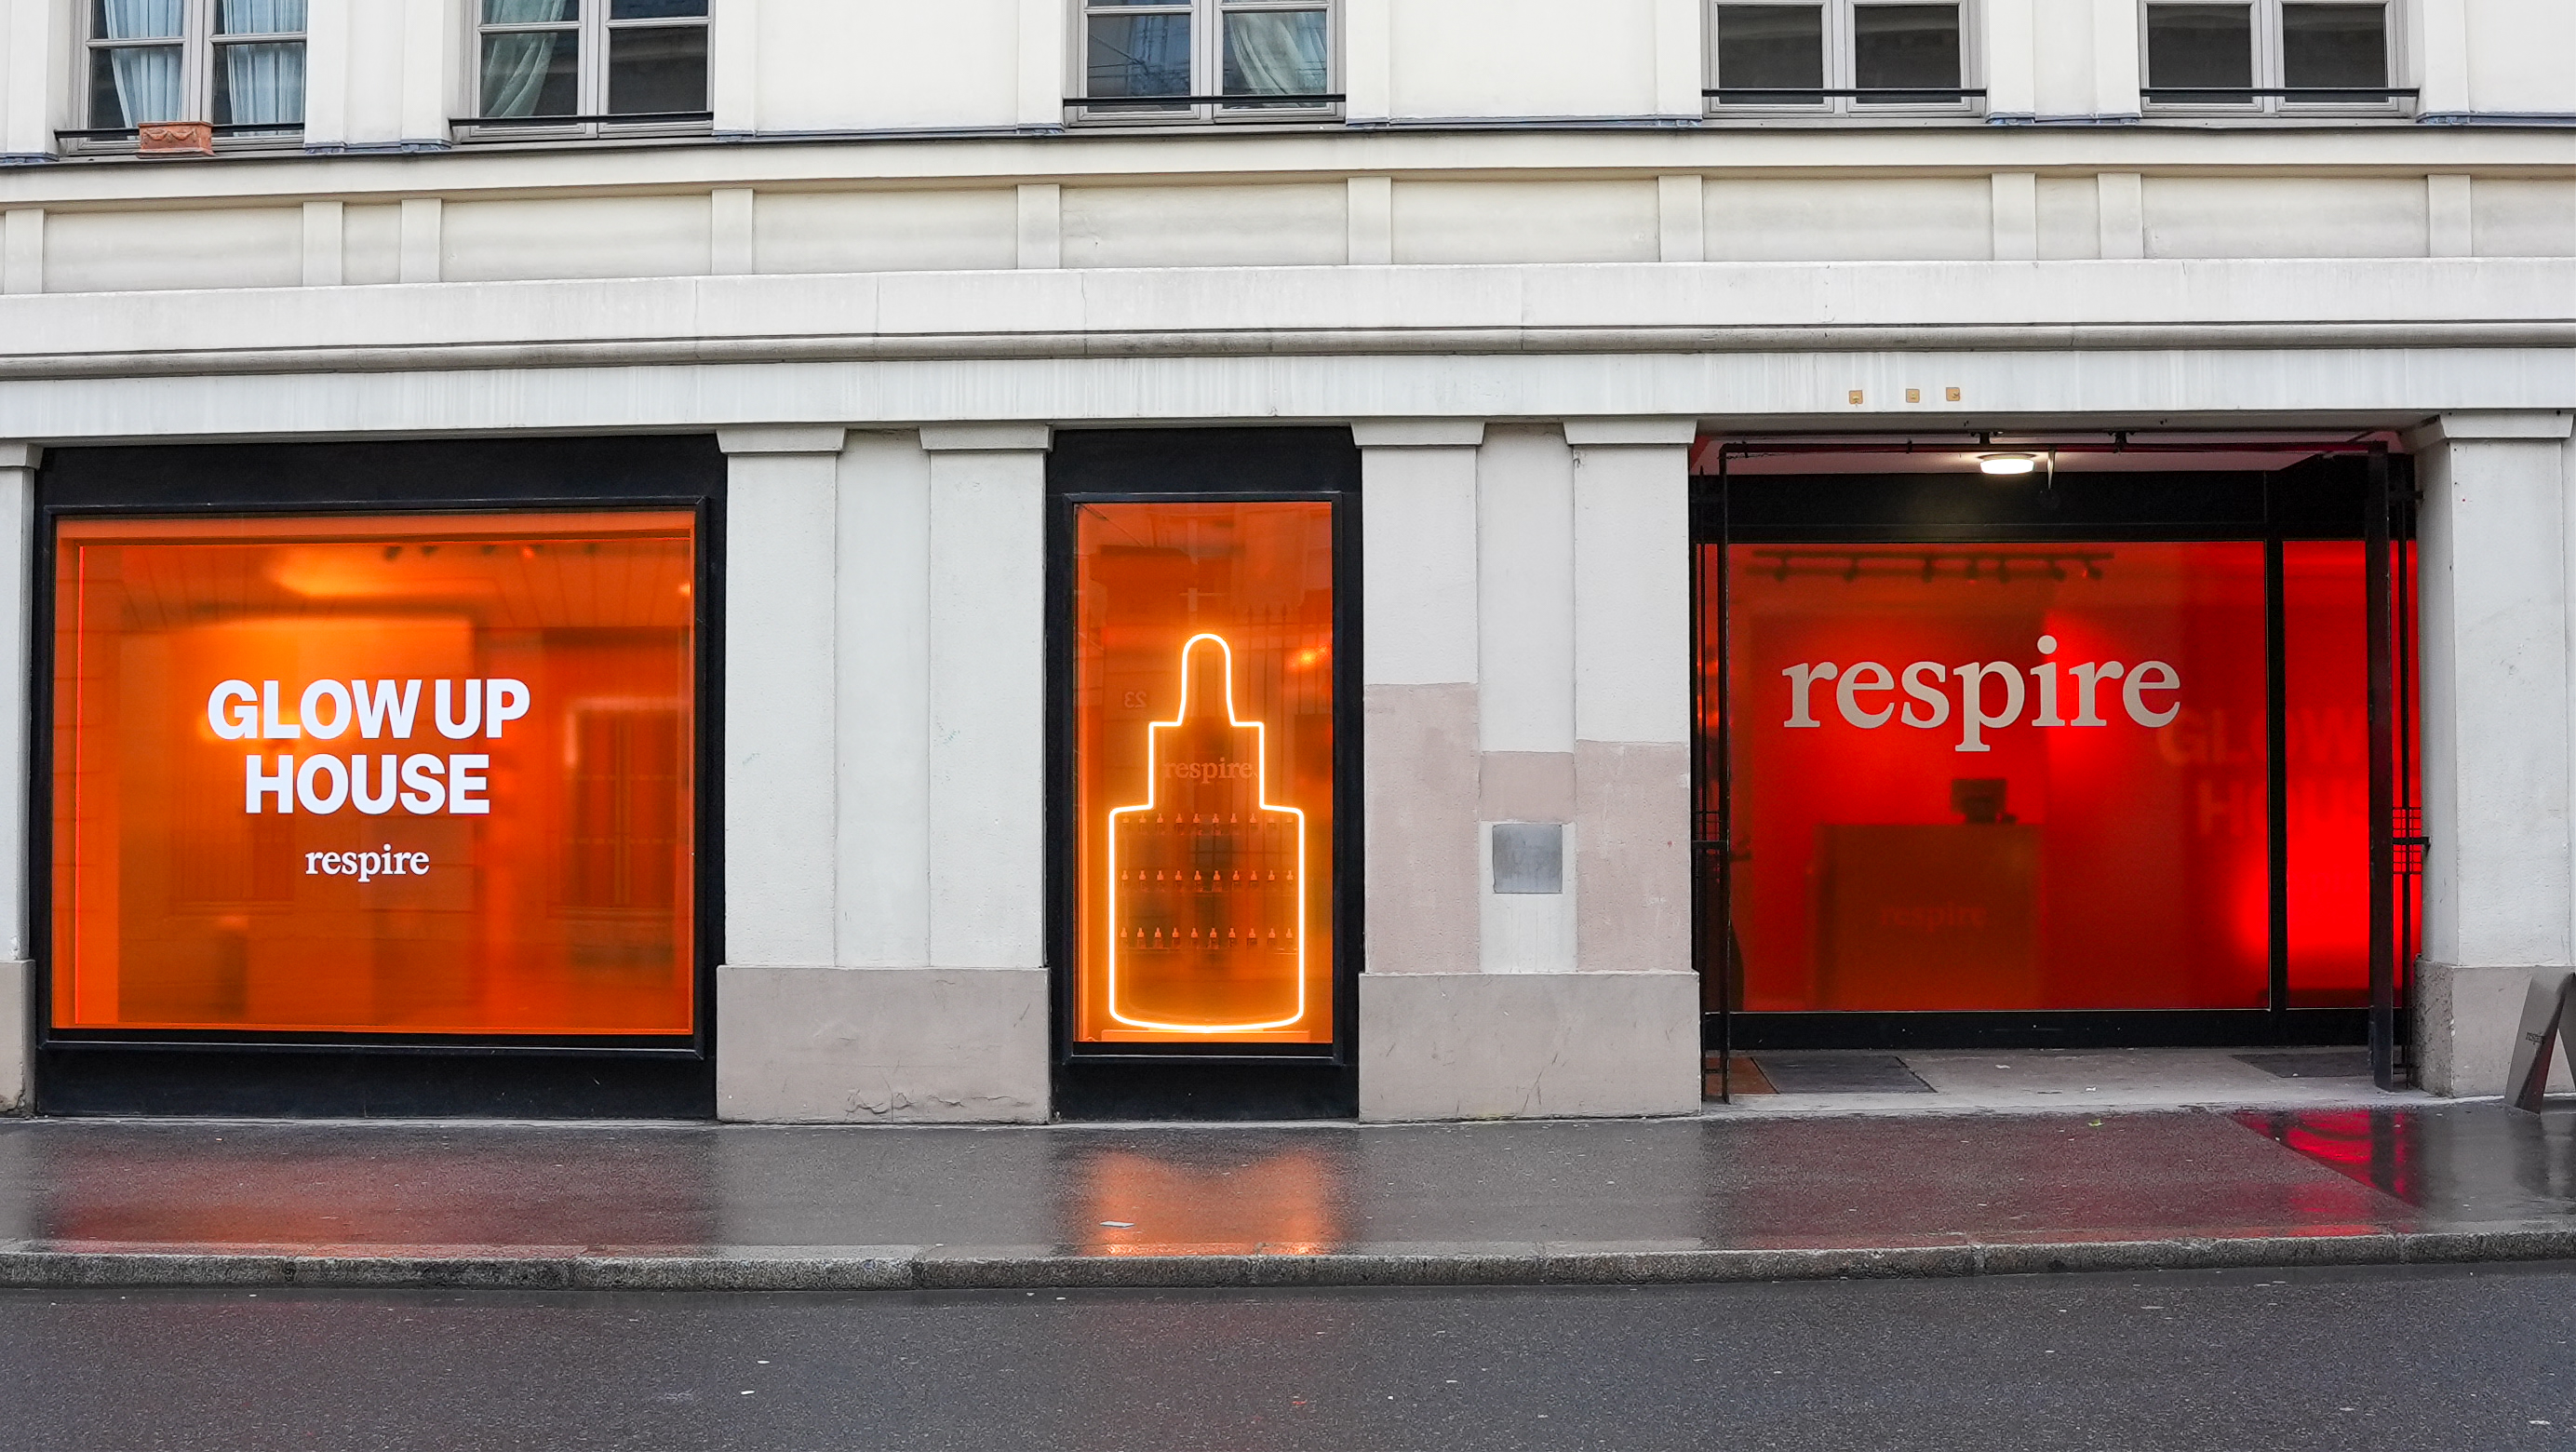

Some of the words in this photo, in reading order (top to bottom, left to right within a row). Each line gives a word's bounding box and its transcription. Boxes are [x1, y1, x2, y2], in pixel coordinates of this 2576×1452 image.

[208, 679, 423, 741] GLOW
[436, 679, 530, 740] UP
[1781, 635, 2180, 752] respire
[245, 754, 490, 815] HOUSE
[1163, 757, 1253, 785] respire
[304, 843, 430, 883] respire
[1880, 901, 1988, 934] respire
